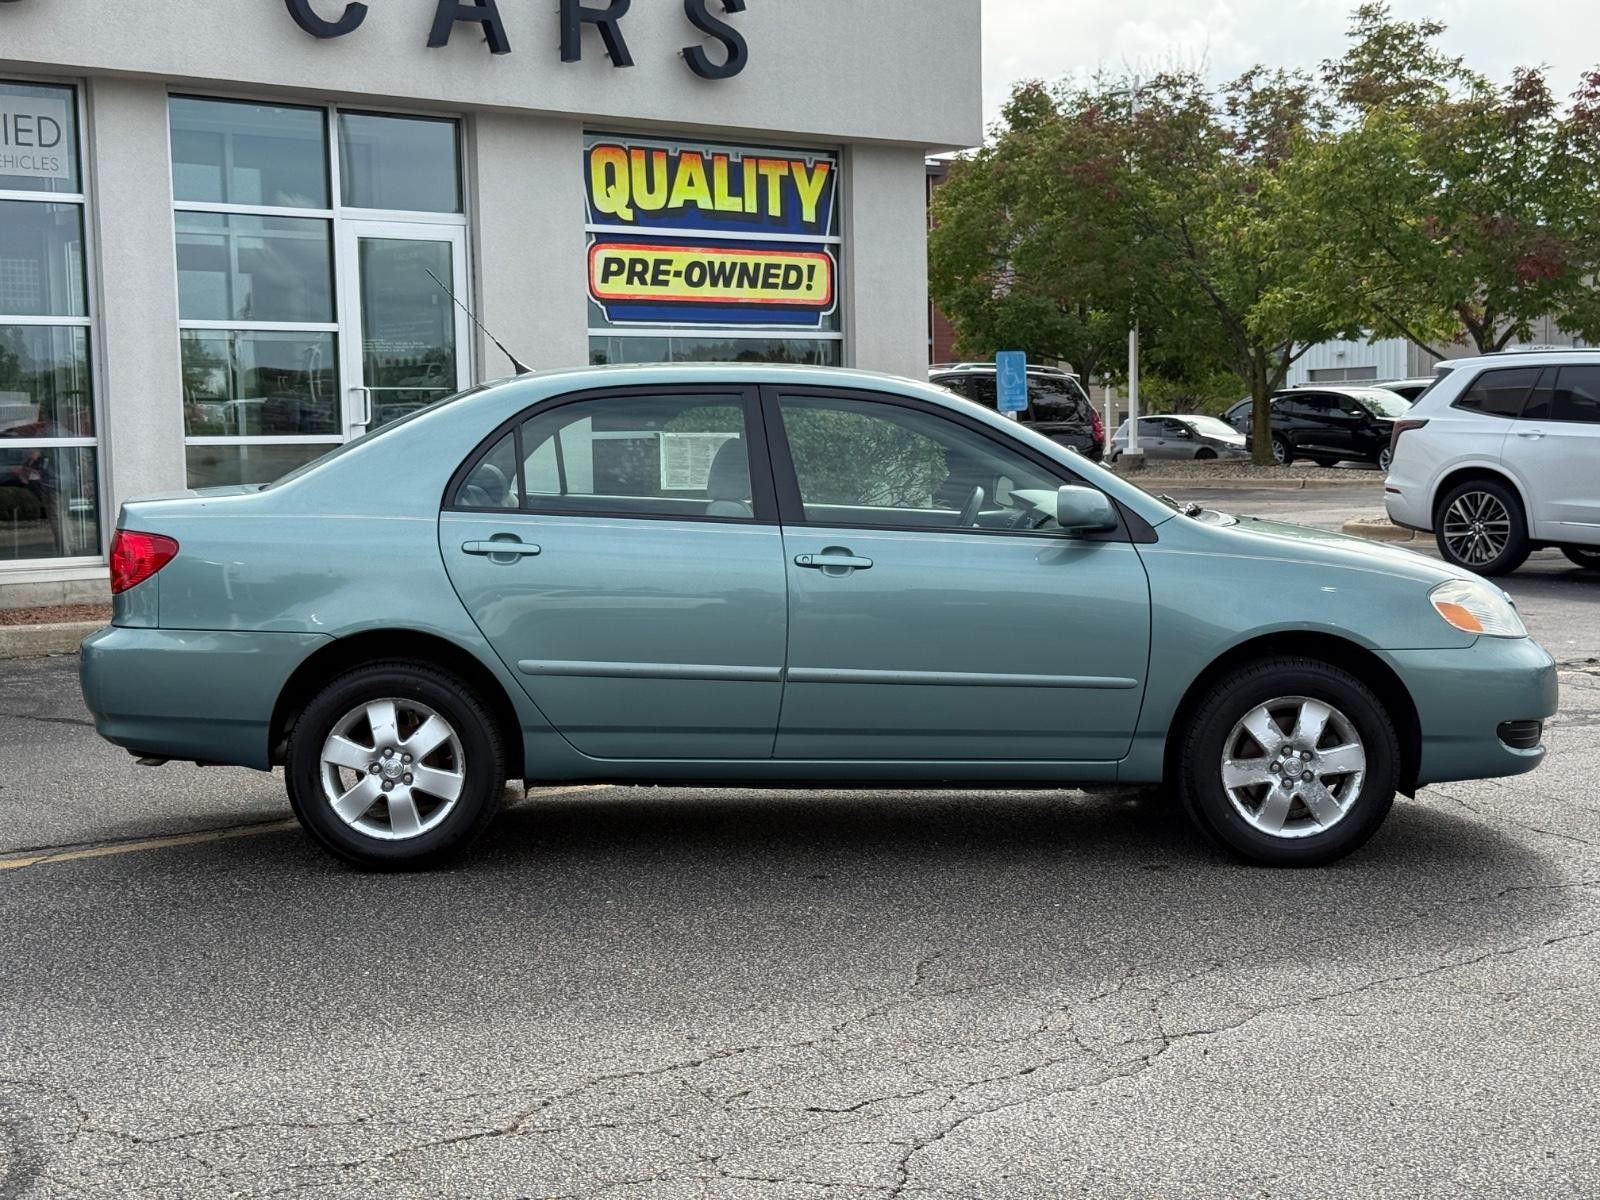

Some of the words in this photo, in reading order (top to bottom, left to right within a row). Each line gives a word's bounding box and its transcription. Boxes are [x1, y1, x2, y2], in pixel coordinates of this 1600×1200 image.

[3, 113, 61, 148] IED
[590, 143, 830, 223] QUALITY
[600, 256, 816, 291] PRE-OWNED!
